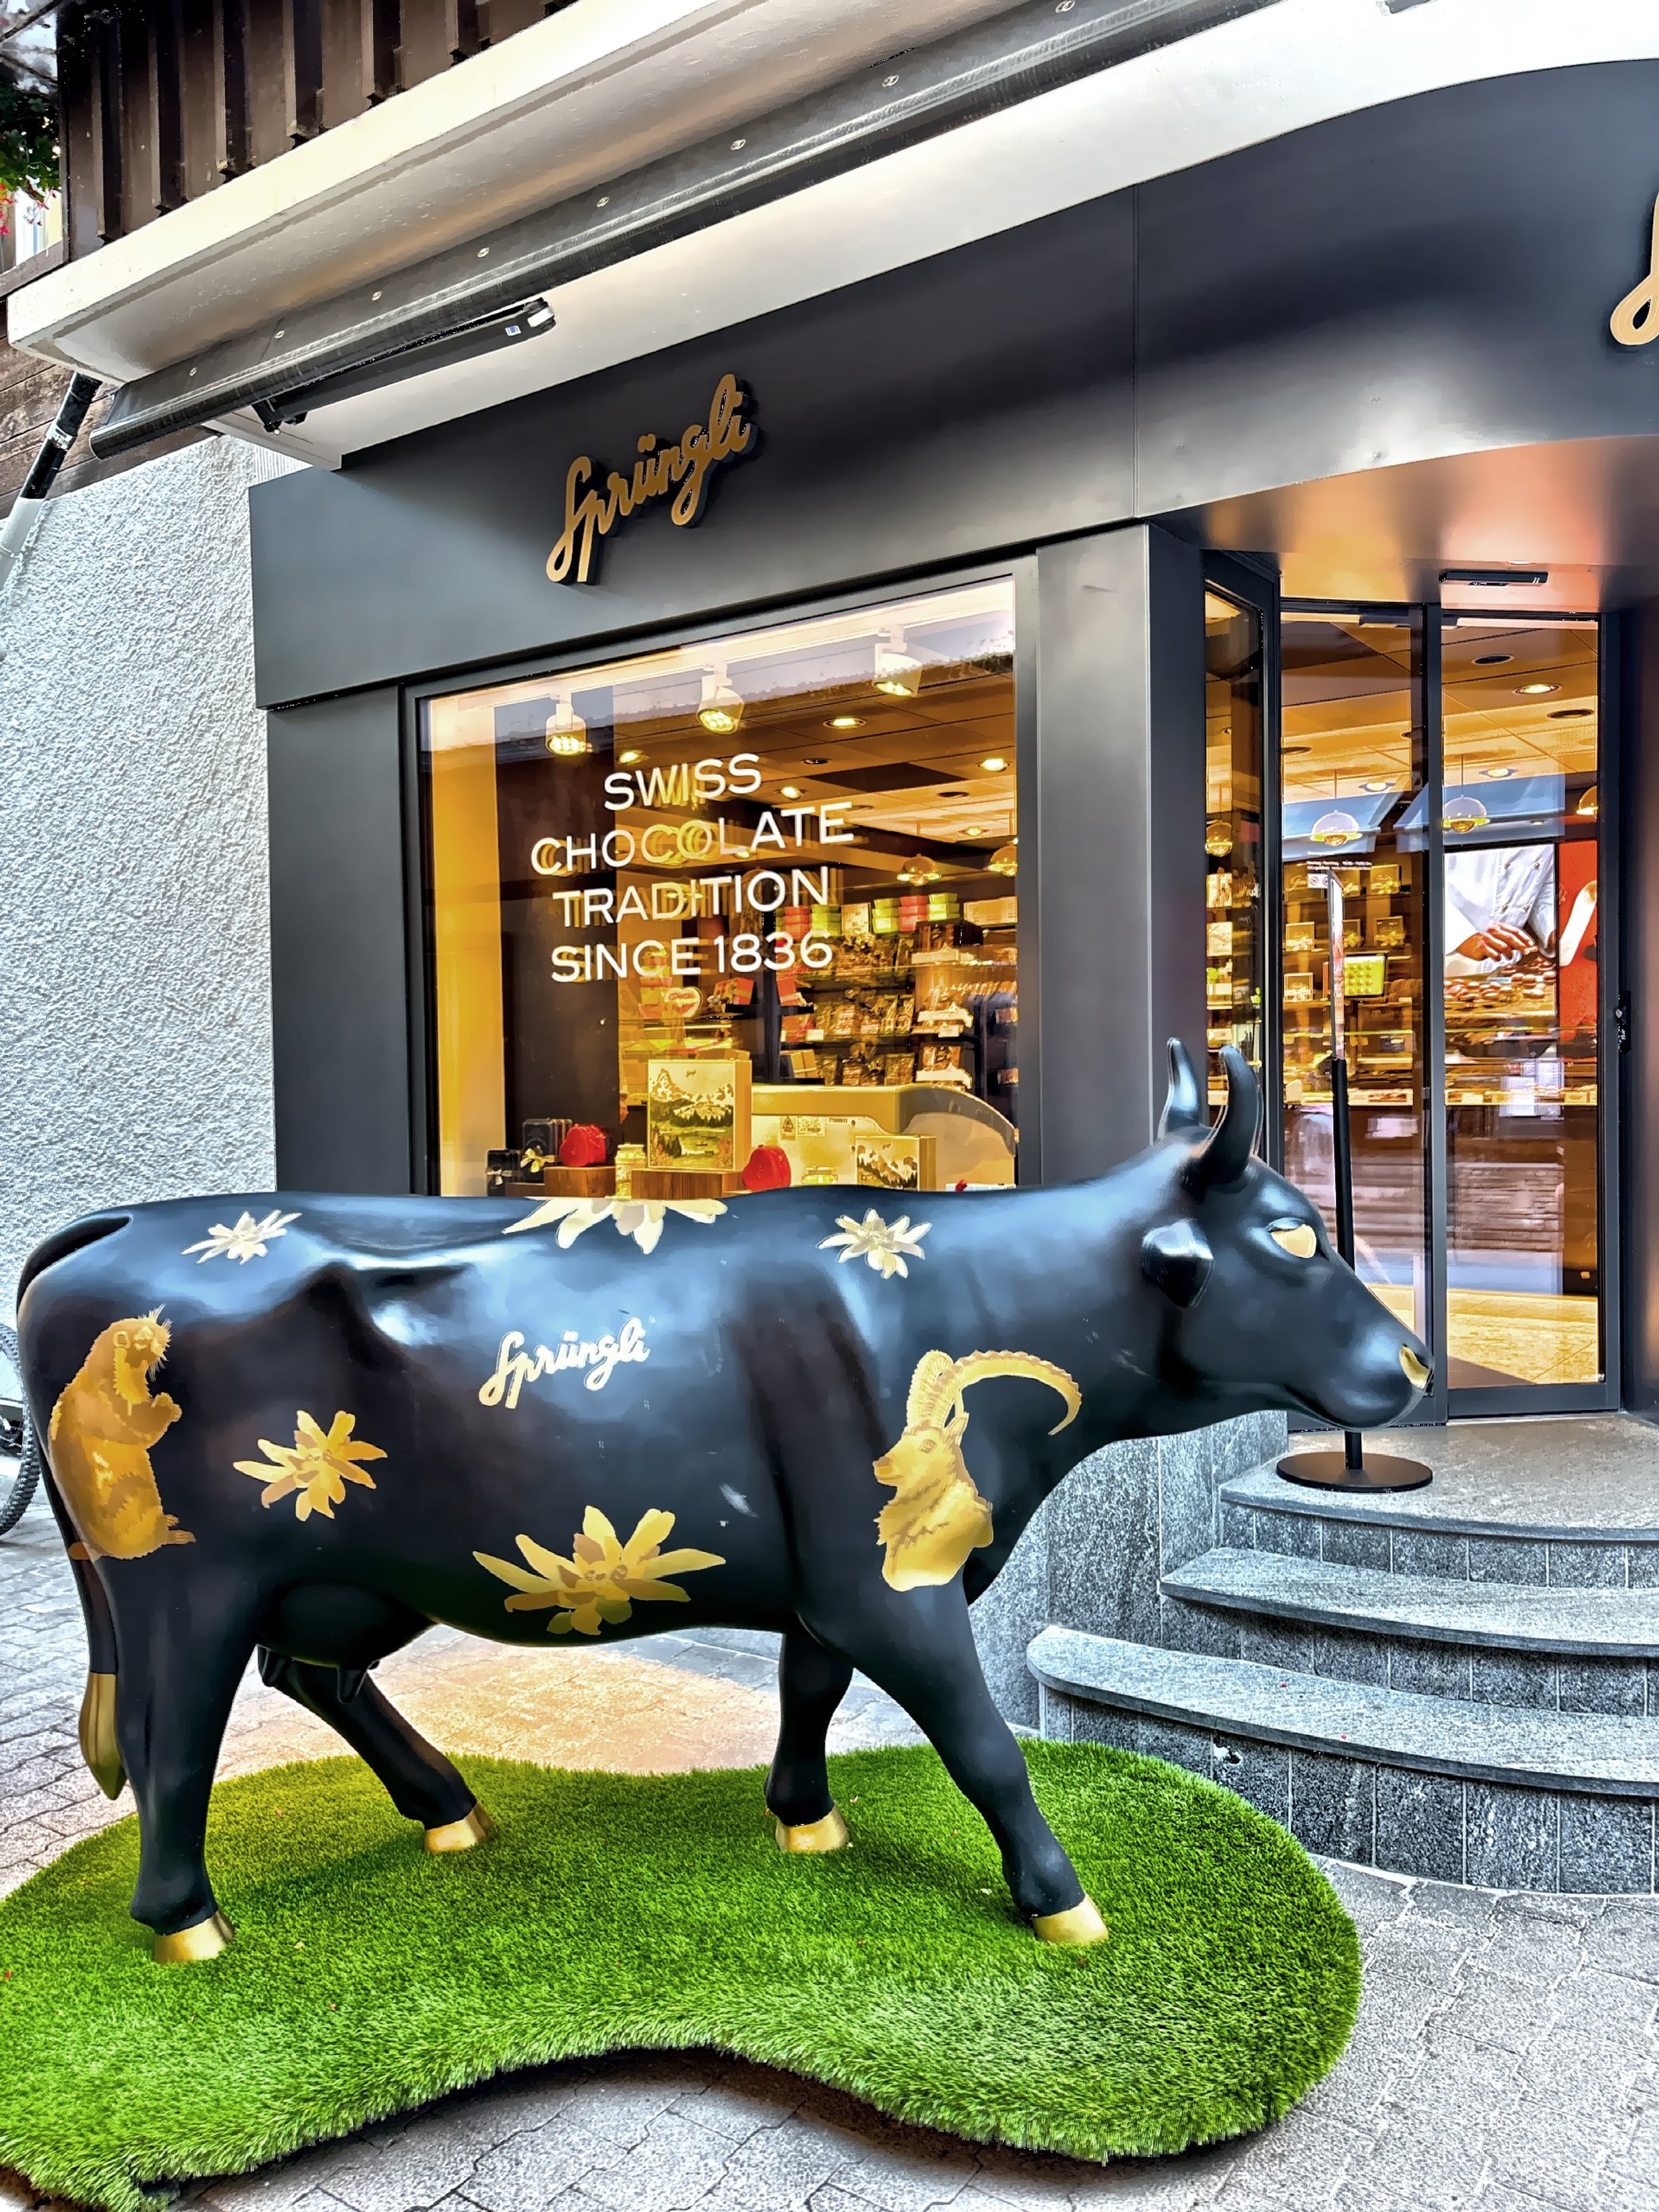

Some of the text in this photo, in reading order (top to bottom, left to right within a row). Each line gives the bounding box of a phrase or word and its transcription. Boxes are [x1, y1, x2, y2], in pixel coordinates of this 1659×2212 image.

[546, 373, 751, 583] Sprüngli
[603, 752, 762, 811] SWISS
[531, 801, 855, 876] CHOCOLATE
[552, 866, 829, 928] TRADITION
[551, 930, 833, 983] SINCE 1836
[478, 1317, 651, 1409] Sprüngli
